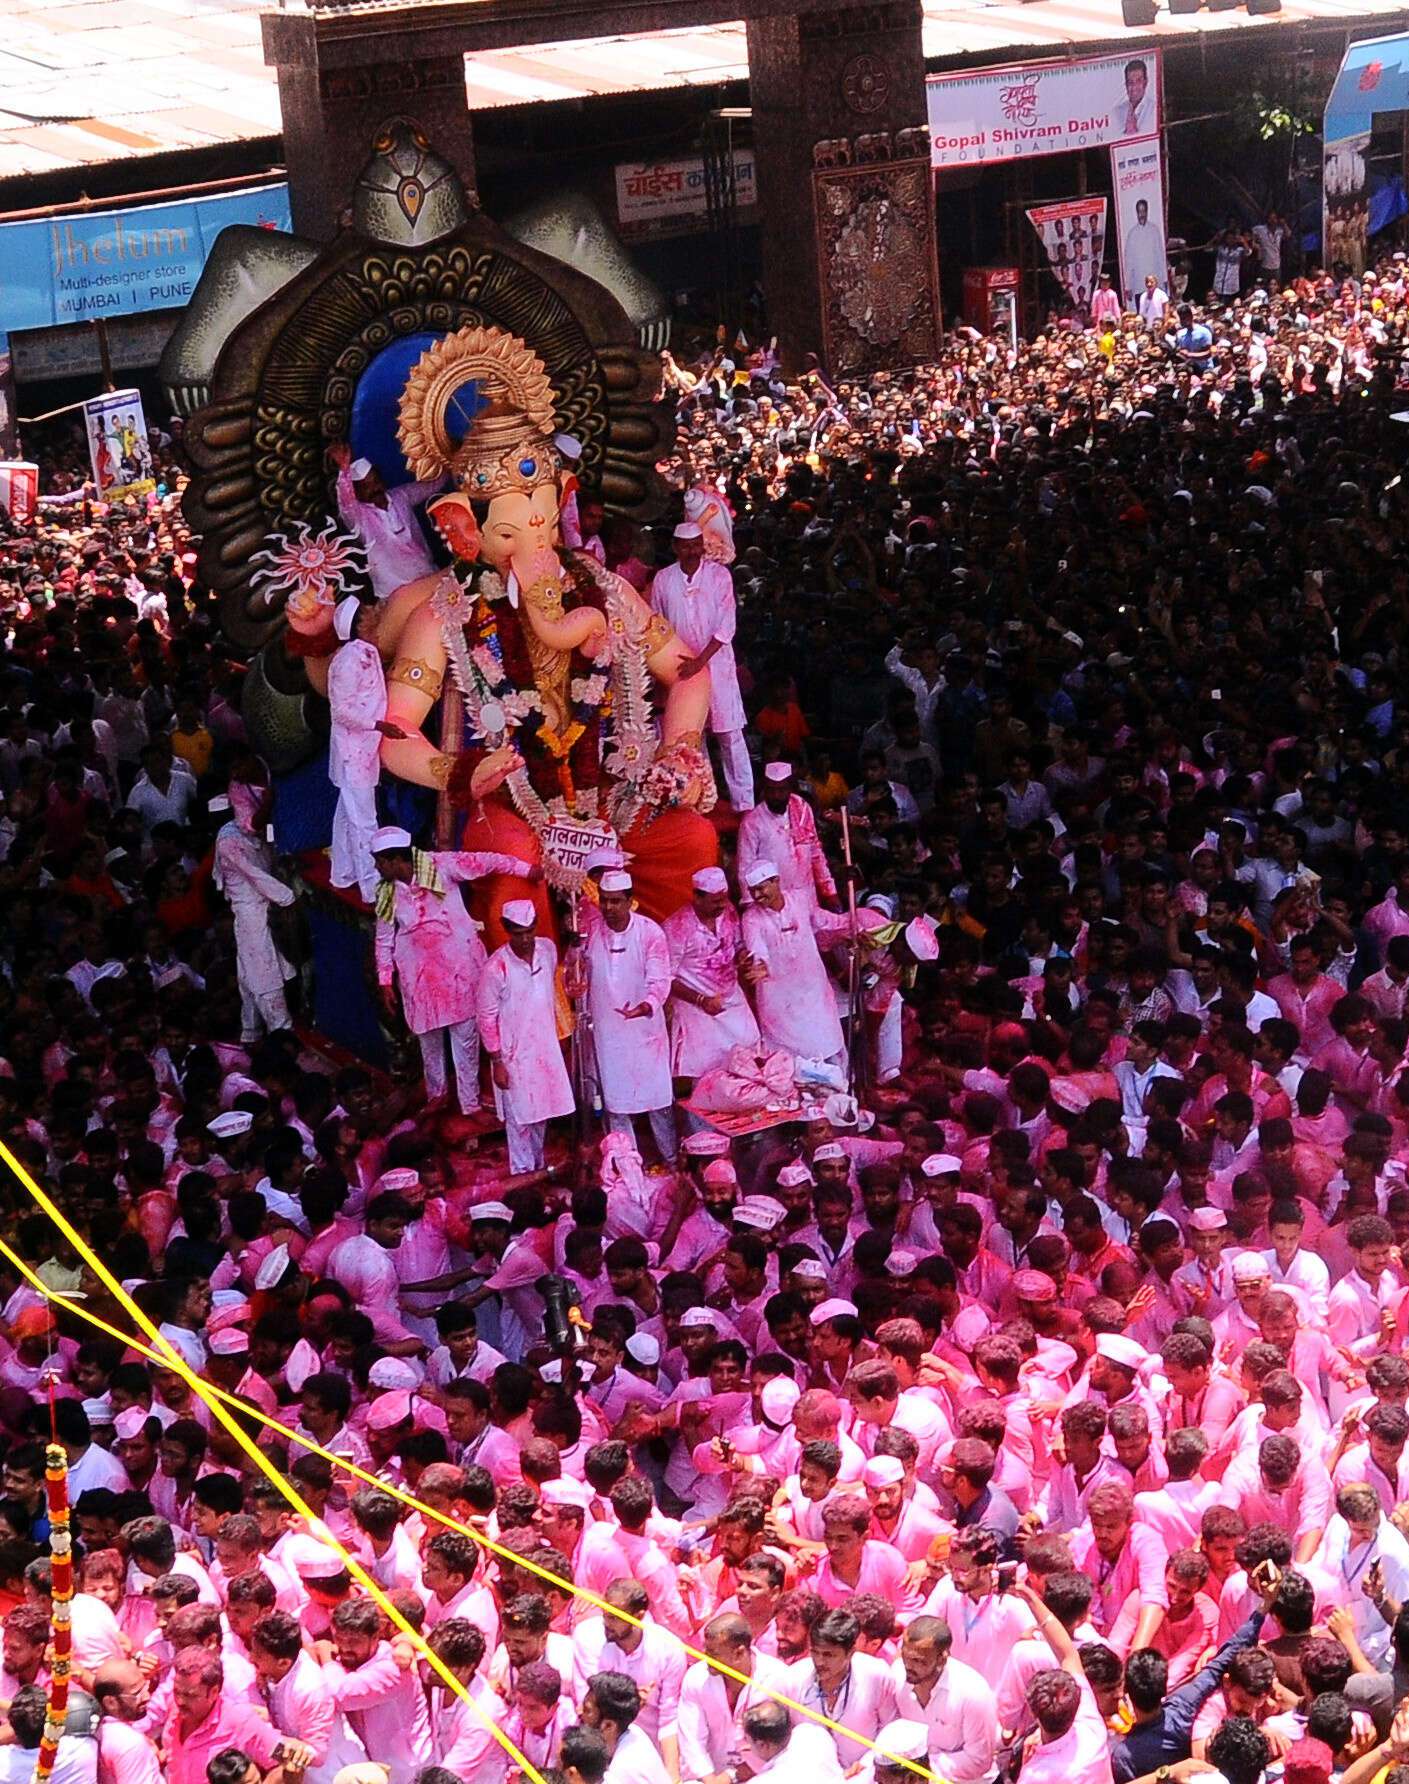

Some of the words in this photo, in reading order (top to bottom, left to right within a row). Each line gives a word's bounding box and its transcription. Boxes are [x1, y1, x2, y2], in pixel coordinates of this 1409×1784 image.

[934, 132, 986, 150] Gopal
[992, 125, 1062, 143] Shivram
[1068, 115, 1110, 132] Dalvi
[940, 132, 1105, 163] FOUNDATION
[53, 217, 189, 278] Jhelum
[60, 269, 151, 291] Multi-designer
[155, 263, 187, 279] store
[60, 292, 121, 313] MUMBAI
[150, 281, 192, 299] PUNE
[558, 848, 588, 869] राज
